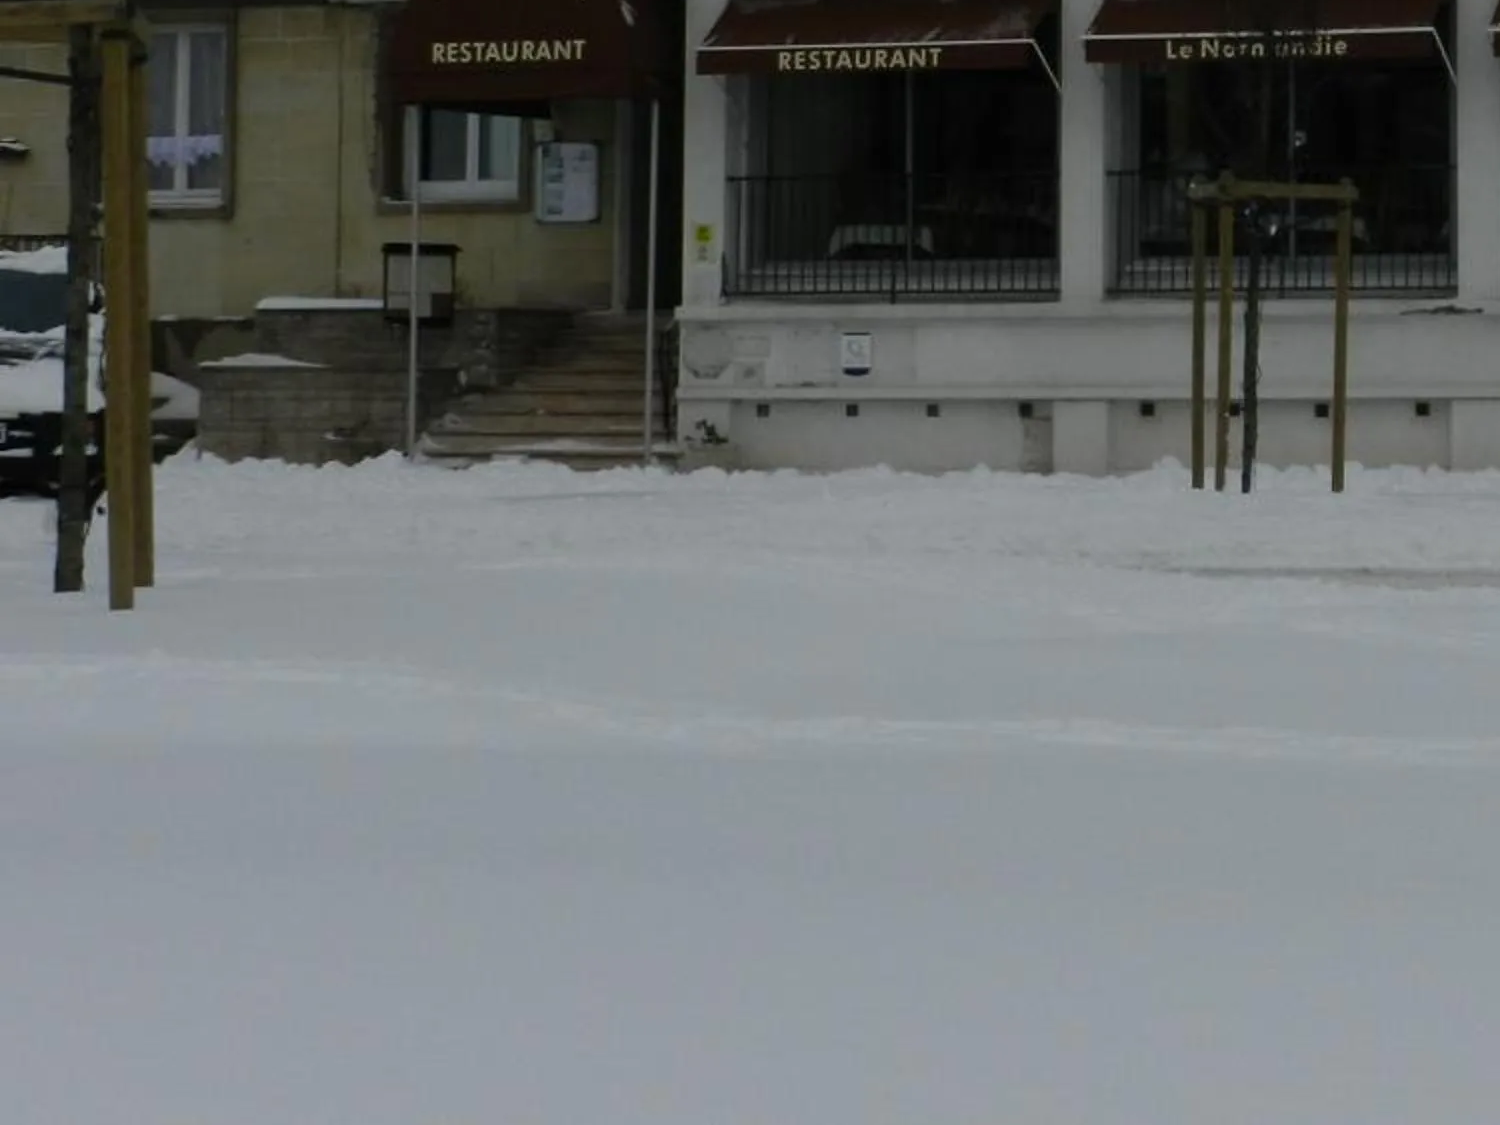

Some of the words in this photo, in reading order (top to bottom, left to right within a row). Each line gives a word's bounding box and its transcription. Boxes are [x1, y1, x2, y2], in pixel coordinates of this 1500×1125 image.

[432, 39, 587, 64] RESTAURANT
[778, 48, 943, 71] RESTAURANT
[1166, 39, 1193, 60] Le
